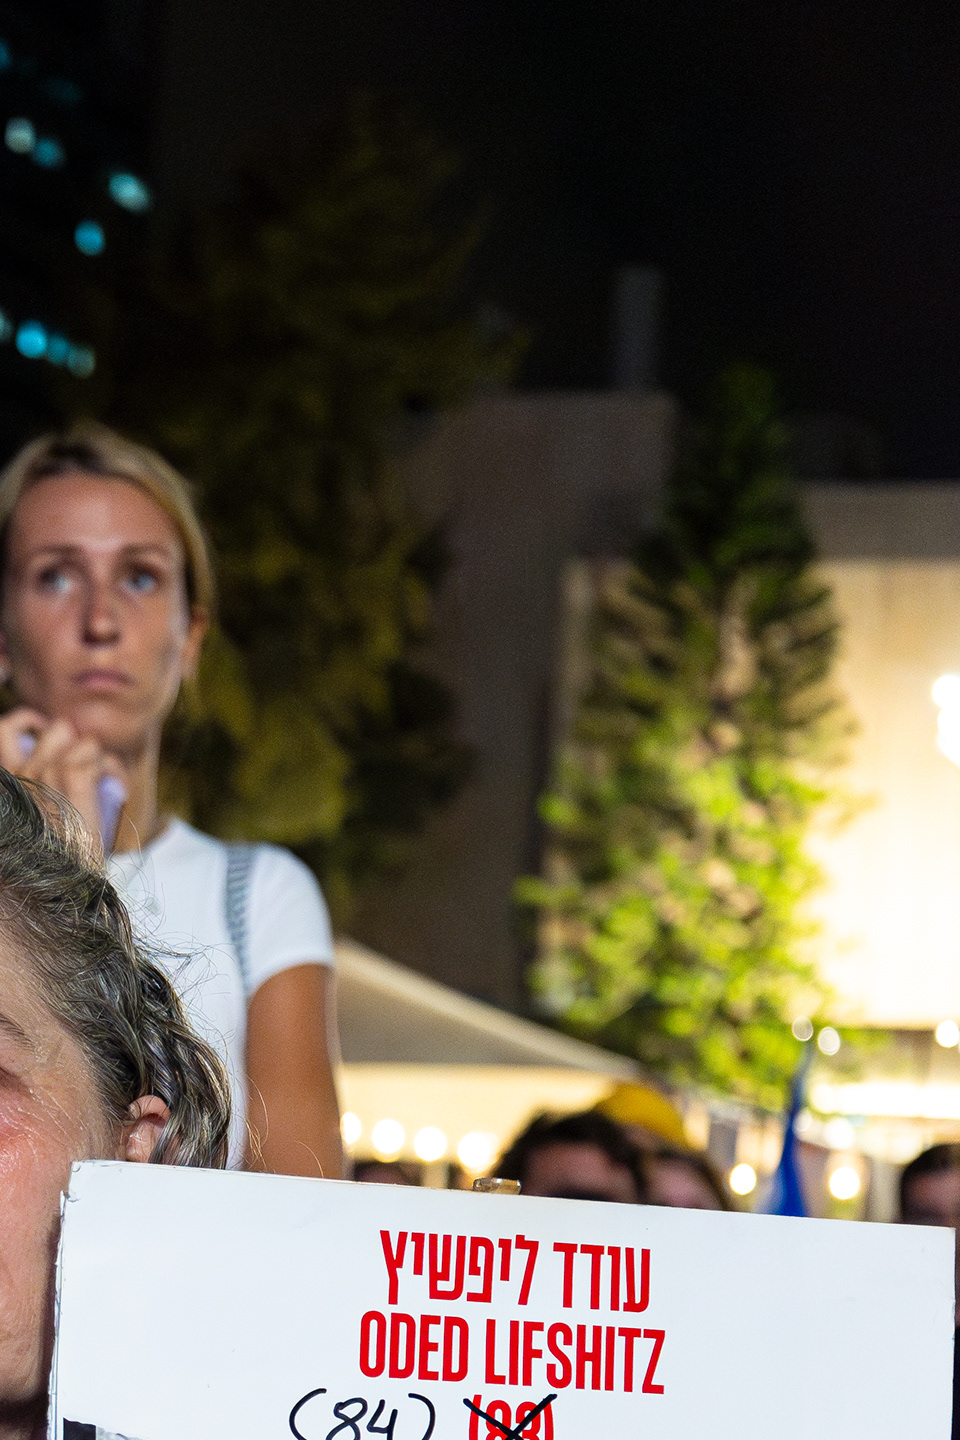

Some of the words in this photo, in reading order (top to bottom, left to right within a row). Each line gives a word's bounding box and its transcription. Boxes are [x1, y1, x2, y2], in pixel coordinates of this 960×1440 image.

[379, 1230, 539, 1306] ליפשיץ
[553, 1242, 651, 1313] עודד
[359, 1310, 469, 1382] ODED
[485, 1318, 666, 1395] LIFSHITZ
